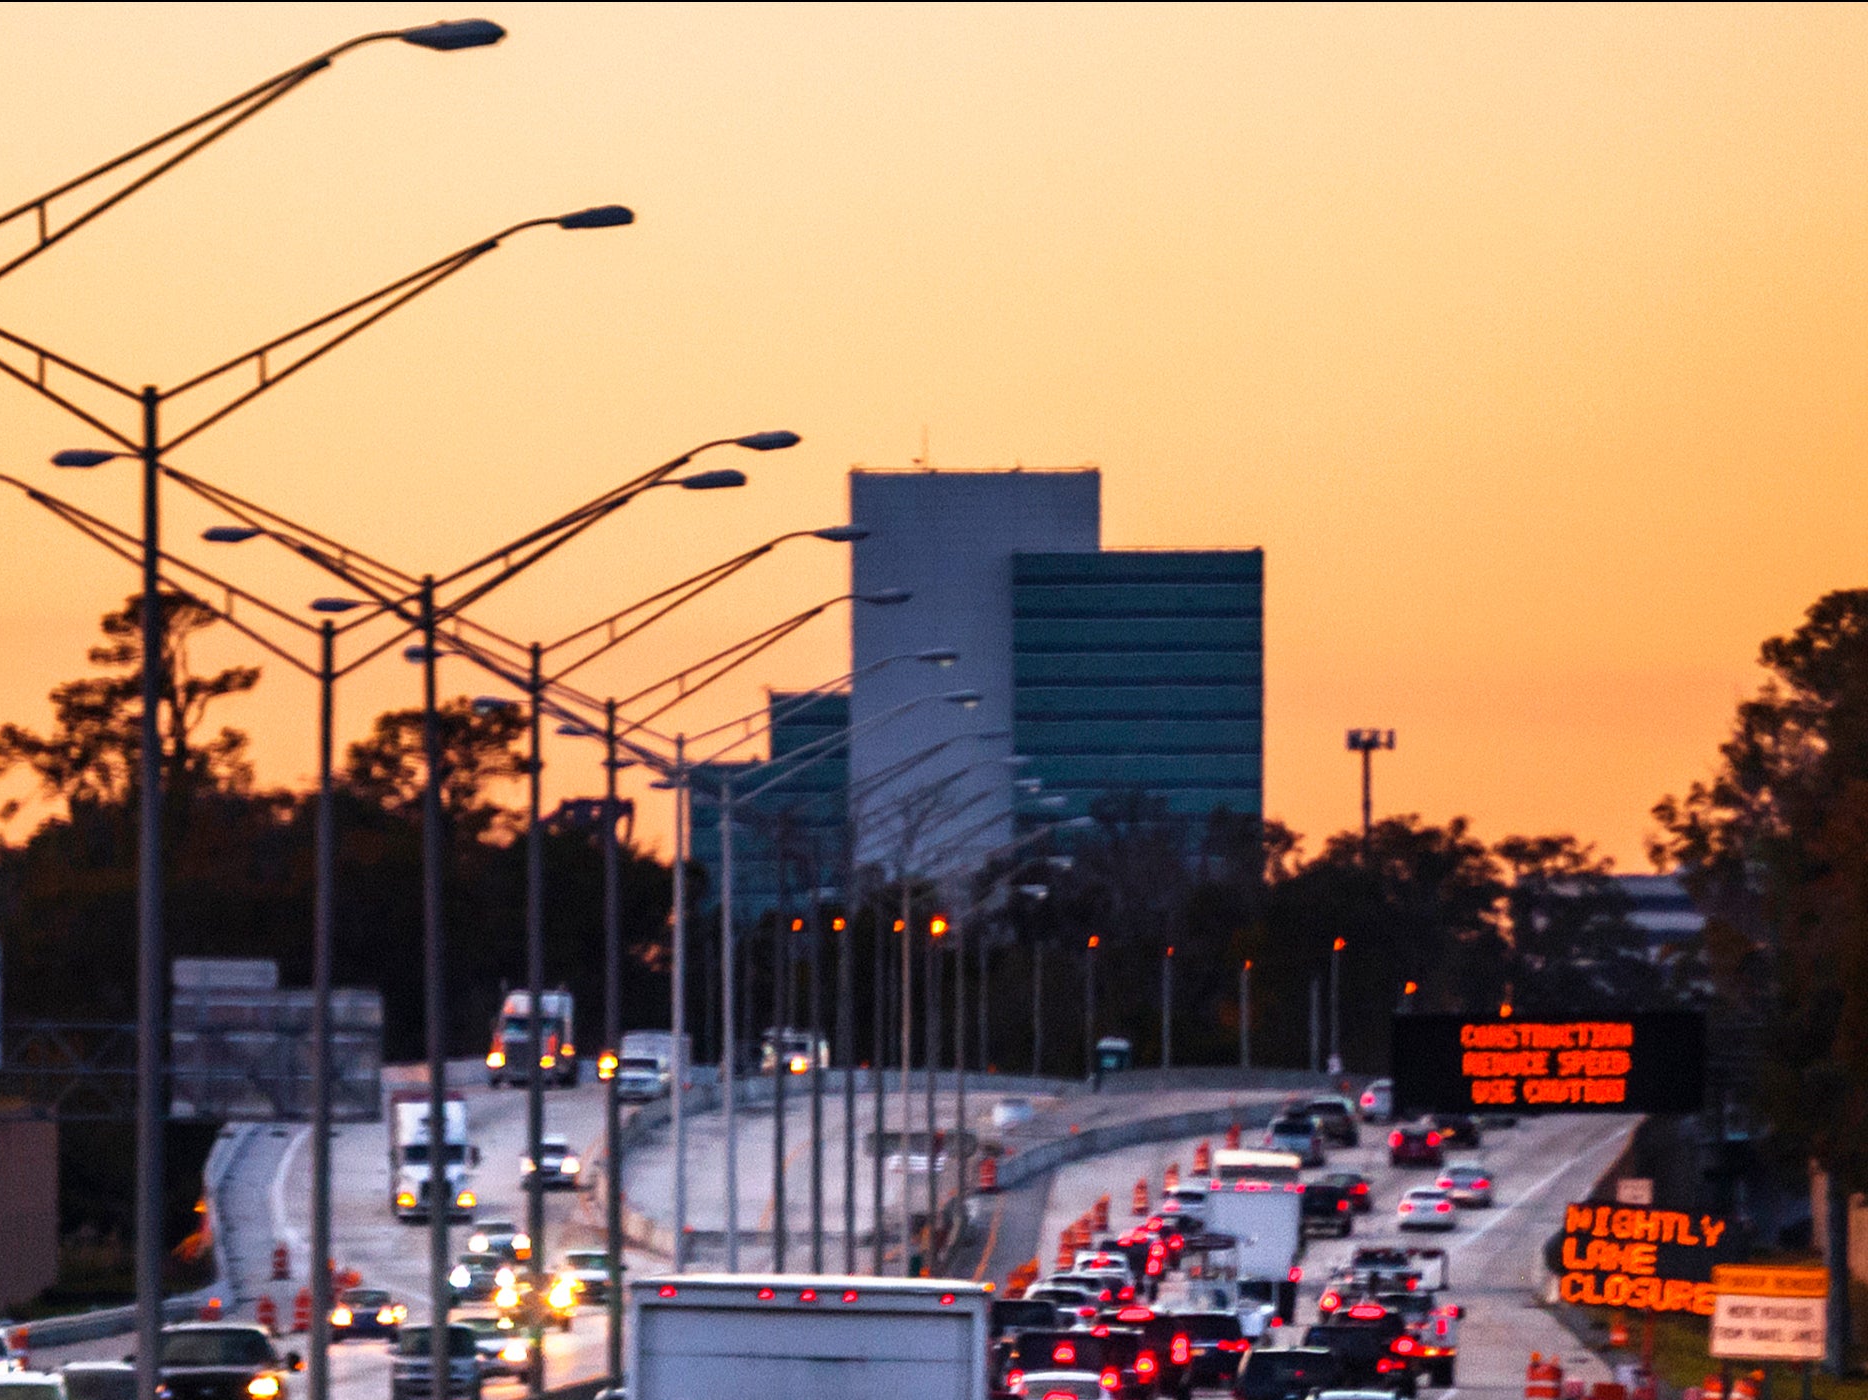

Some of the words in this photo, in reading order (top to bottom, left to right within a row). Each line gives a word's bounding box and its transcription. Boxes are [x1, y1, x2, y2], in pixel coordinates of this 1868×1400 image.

[1460, 1022, 1634, 1049] CONSTRUCTION
[1462, 1050, 1550, 1077] REDUCE
[1557, 1050, 1631, 1077] SPEED
[1471, 1078, 1517, 1104] USE
[1523, 1078, 1626, 1104] CAUTION
[1566, 1203, 1726, 1247] NIGHTLY
[1562, 1237, 1658, 1275] LANE
